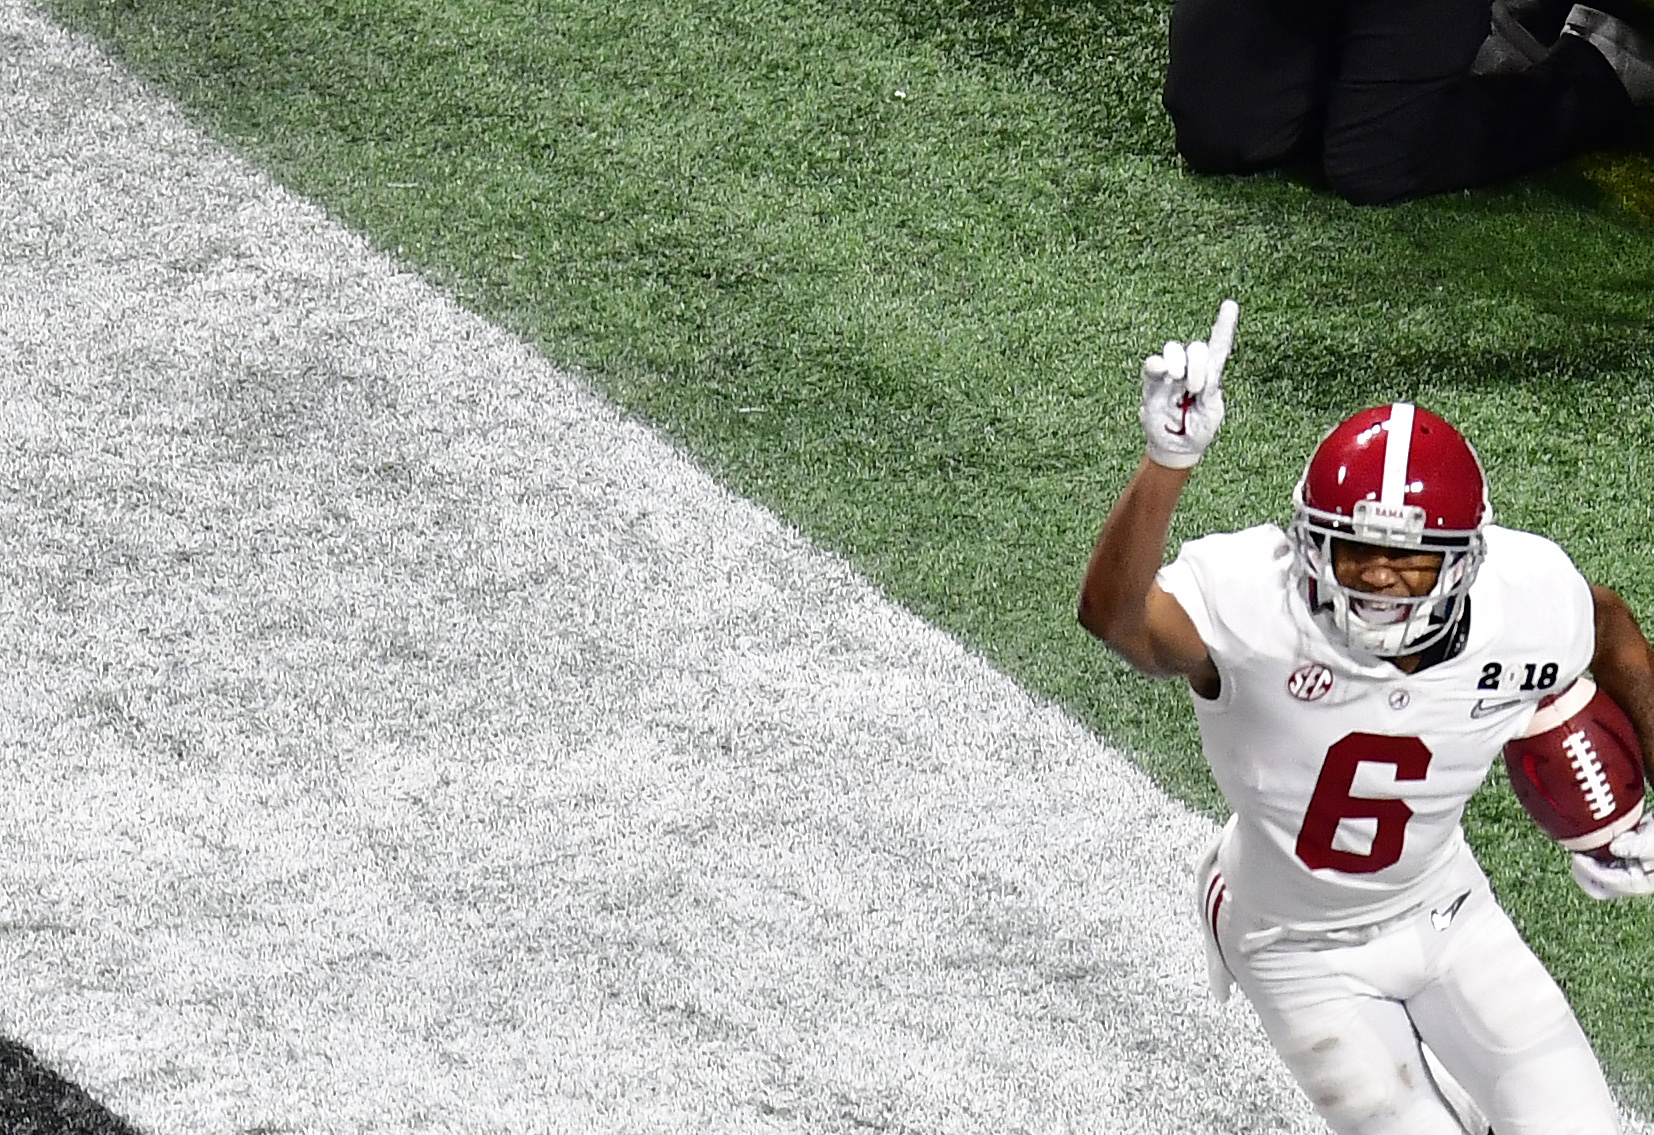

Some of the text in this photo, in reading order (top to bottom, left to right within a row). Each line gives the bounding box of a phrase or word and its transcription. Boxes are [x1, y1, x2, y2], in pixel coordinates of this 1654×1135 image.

[1288, 664, 1333, 701] SEC
[1476, 662, 1559, 691] 2018
[1295, 731, 1433, 874] 6
